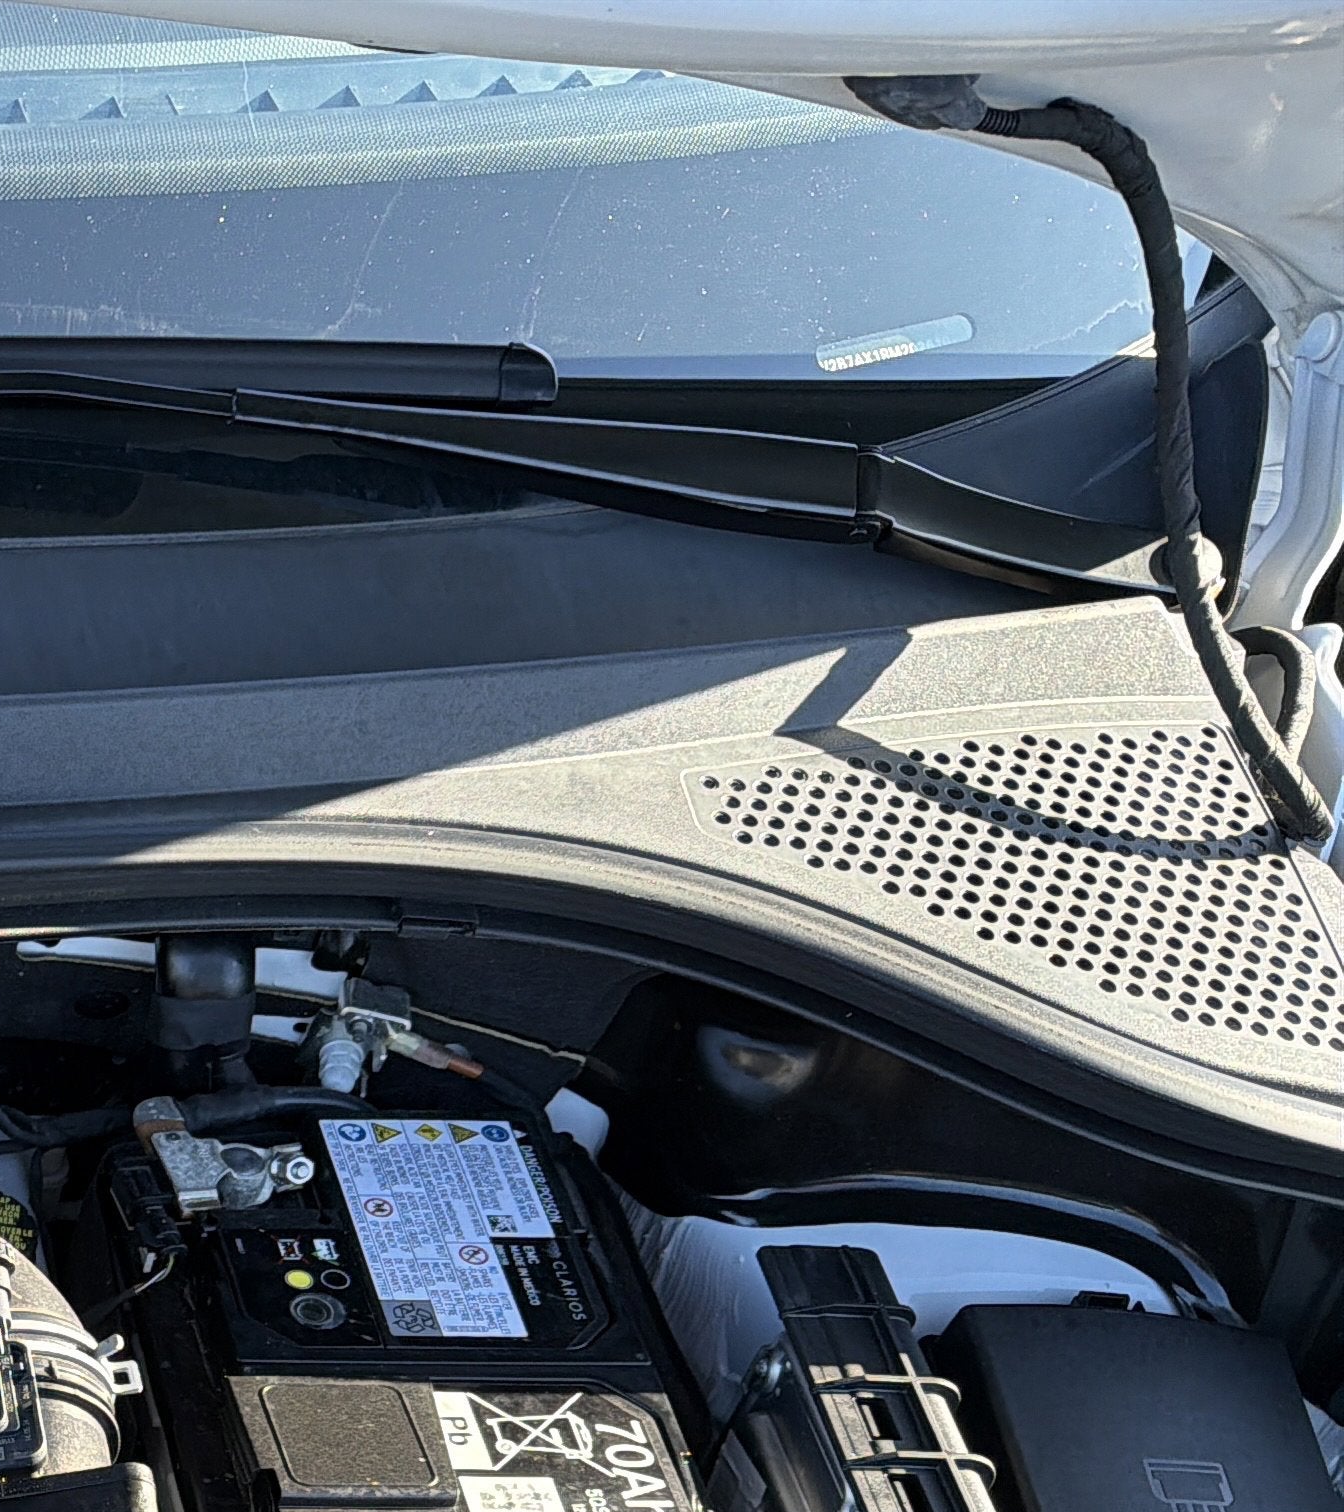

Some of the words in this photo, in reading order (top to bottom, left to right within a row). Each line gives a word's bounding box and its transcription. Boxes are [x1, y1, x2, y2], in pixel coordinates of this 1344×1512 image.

[519, 1145, 563, 1222] DANGER/POISON
[508, 1245, 525, 1266] MADE
[517, 1267, 529, 1276] IN
[550, 1261, 587, 1320] CLARIOS
[441, 1416, 474, 1445] Pb
